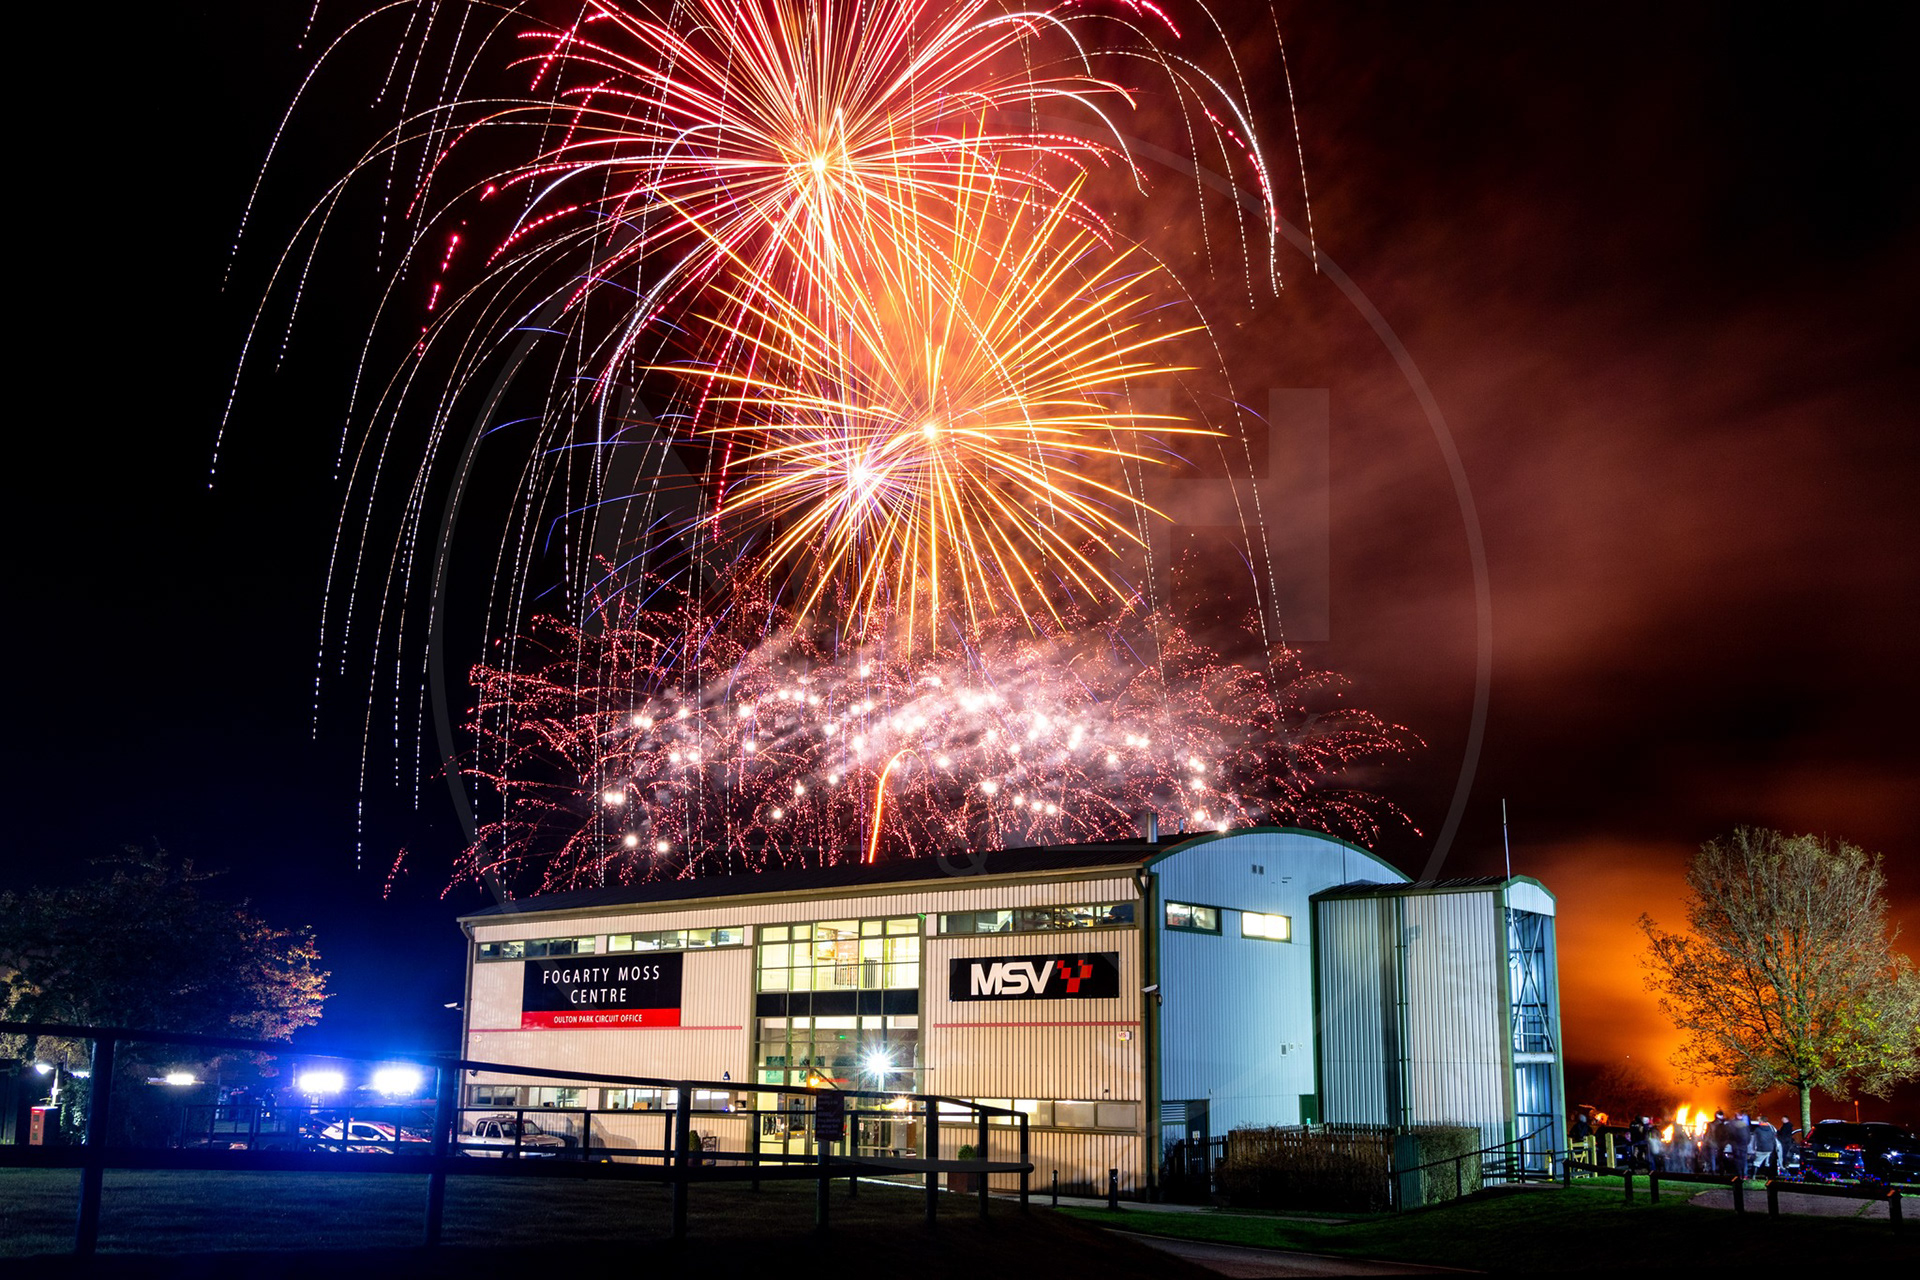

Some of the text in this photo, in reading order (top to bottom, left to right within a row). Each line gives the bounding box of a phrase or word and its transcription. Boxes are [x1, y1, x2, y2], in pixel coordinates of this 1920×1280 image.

[543, 965, 660, 984] FOGARTY MOSS
[970, 960, 1056, 996] MSV
[570, 987, 627, 1004] CENTRE
[553, 1014, 643, 1024] OULTON PARK CIRCUIT OFFICE
